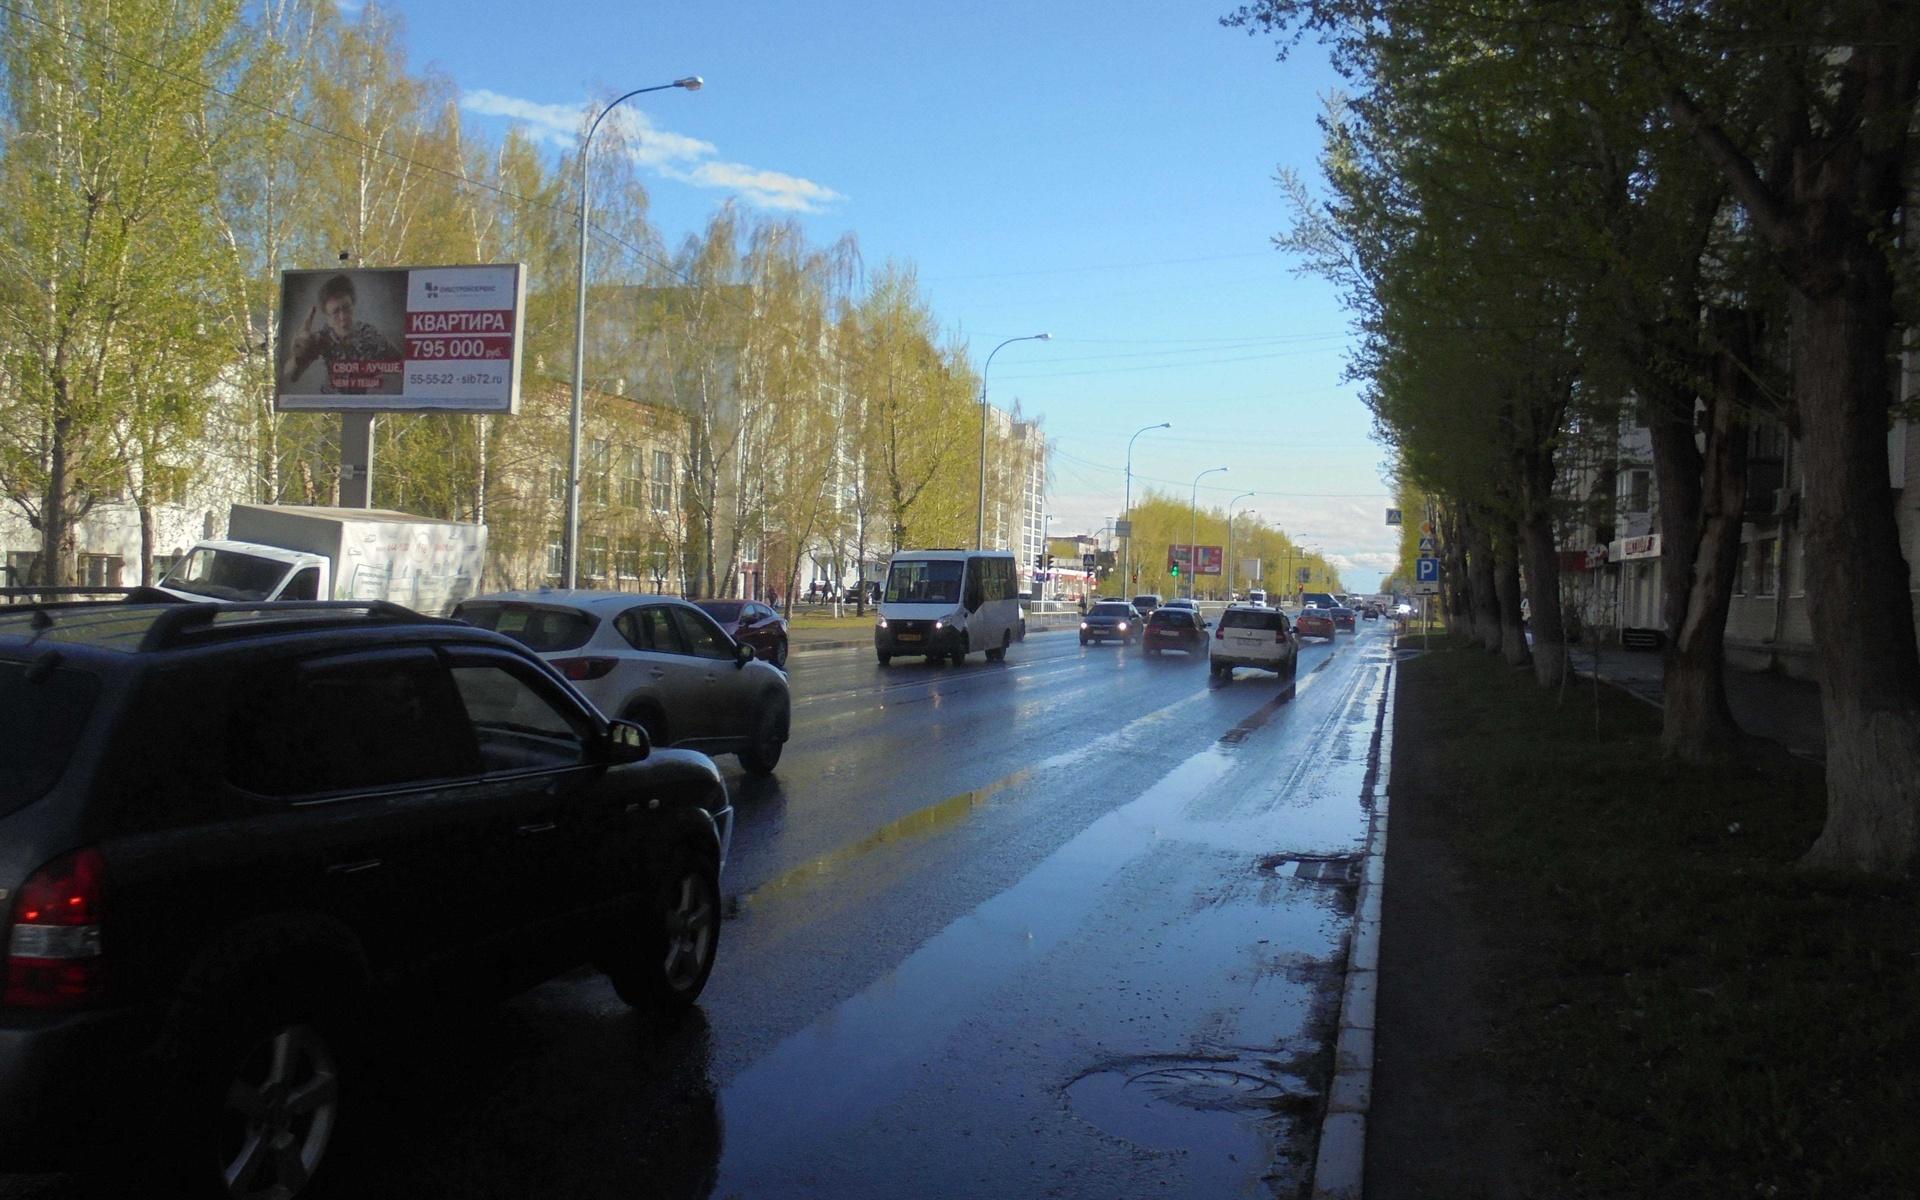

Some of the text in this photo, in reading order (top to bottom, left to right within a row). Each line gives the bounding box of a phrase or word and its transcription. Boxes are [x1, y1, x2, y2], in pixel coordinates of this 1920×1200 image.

[412, 313, 505, 331] КВАРТИРА
[411, 340, 446, 358] 795
[449, 340, 485, 357] 000
[333, 362, 360, 373] СВОЯ
[410, 373, 455, 385] 55-55-22
[461, 373, 503, 385] sib72.ru
[1420, 561, 1433, 579] P
